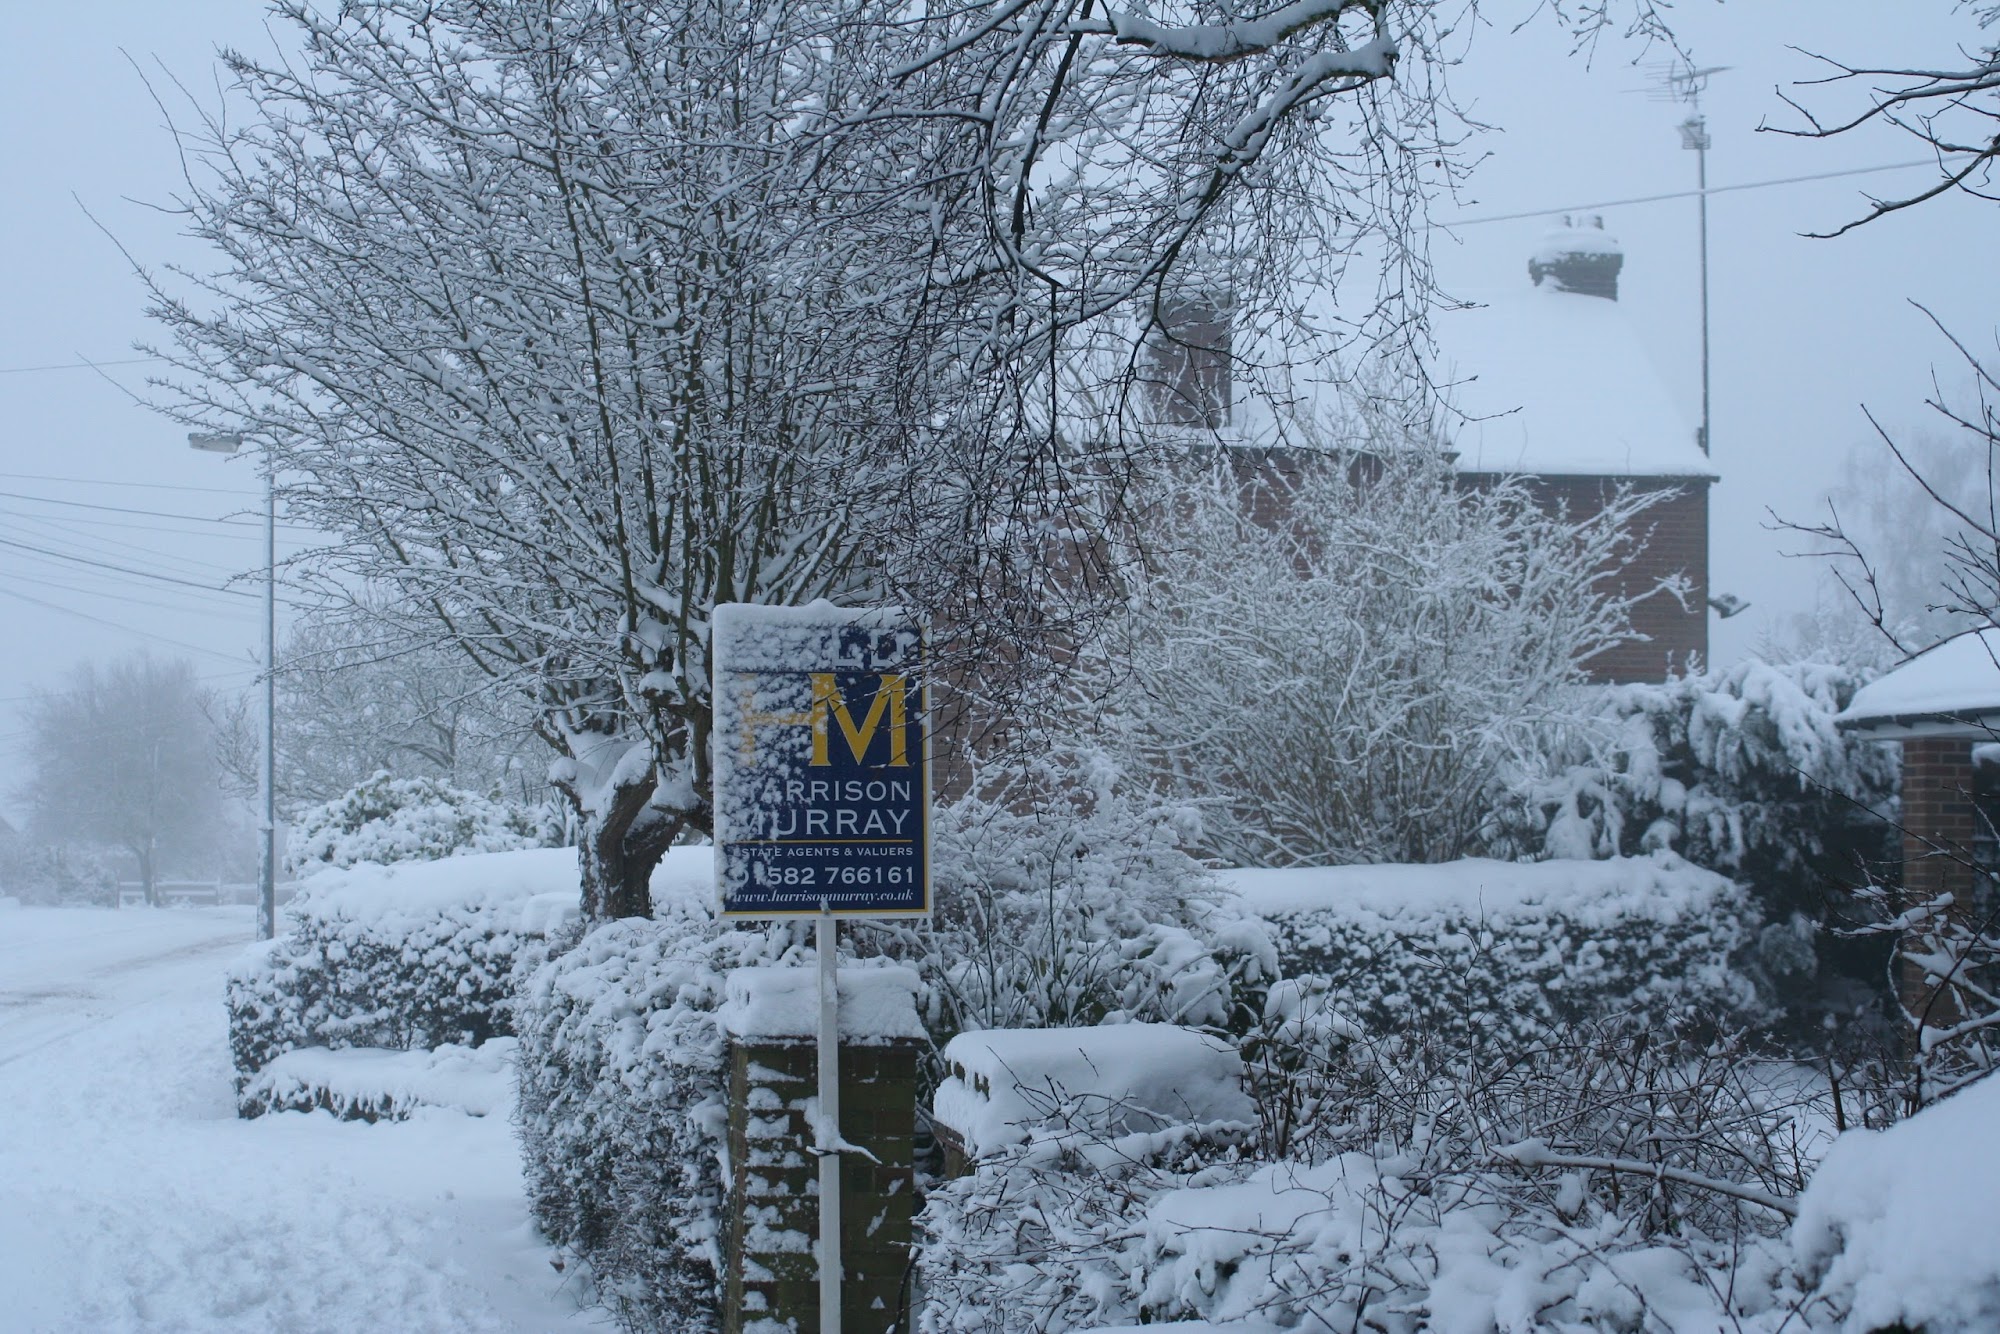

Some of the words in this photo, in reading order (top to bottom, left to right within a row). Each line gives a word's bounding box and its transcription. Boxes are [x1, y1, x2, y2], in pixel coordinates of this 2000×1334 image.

[736, 779, 911, 802] ARRISON
[734, 847, 782, 857] STATE
[787, 847, 839, 857] AGENTS
[844, 847, 853, 857] &
[857, 847, 914, 857] VALUERS
[825, 866, 914, 885] 766161
[733, 889, 914, 904] www.harrisonmurray.co.uk
